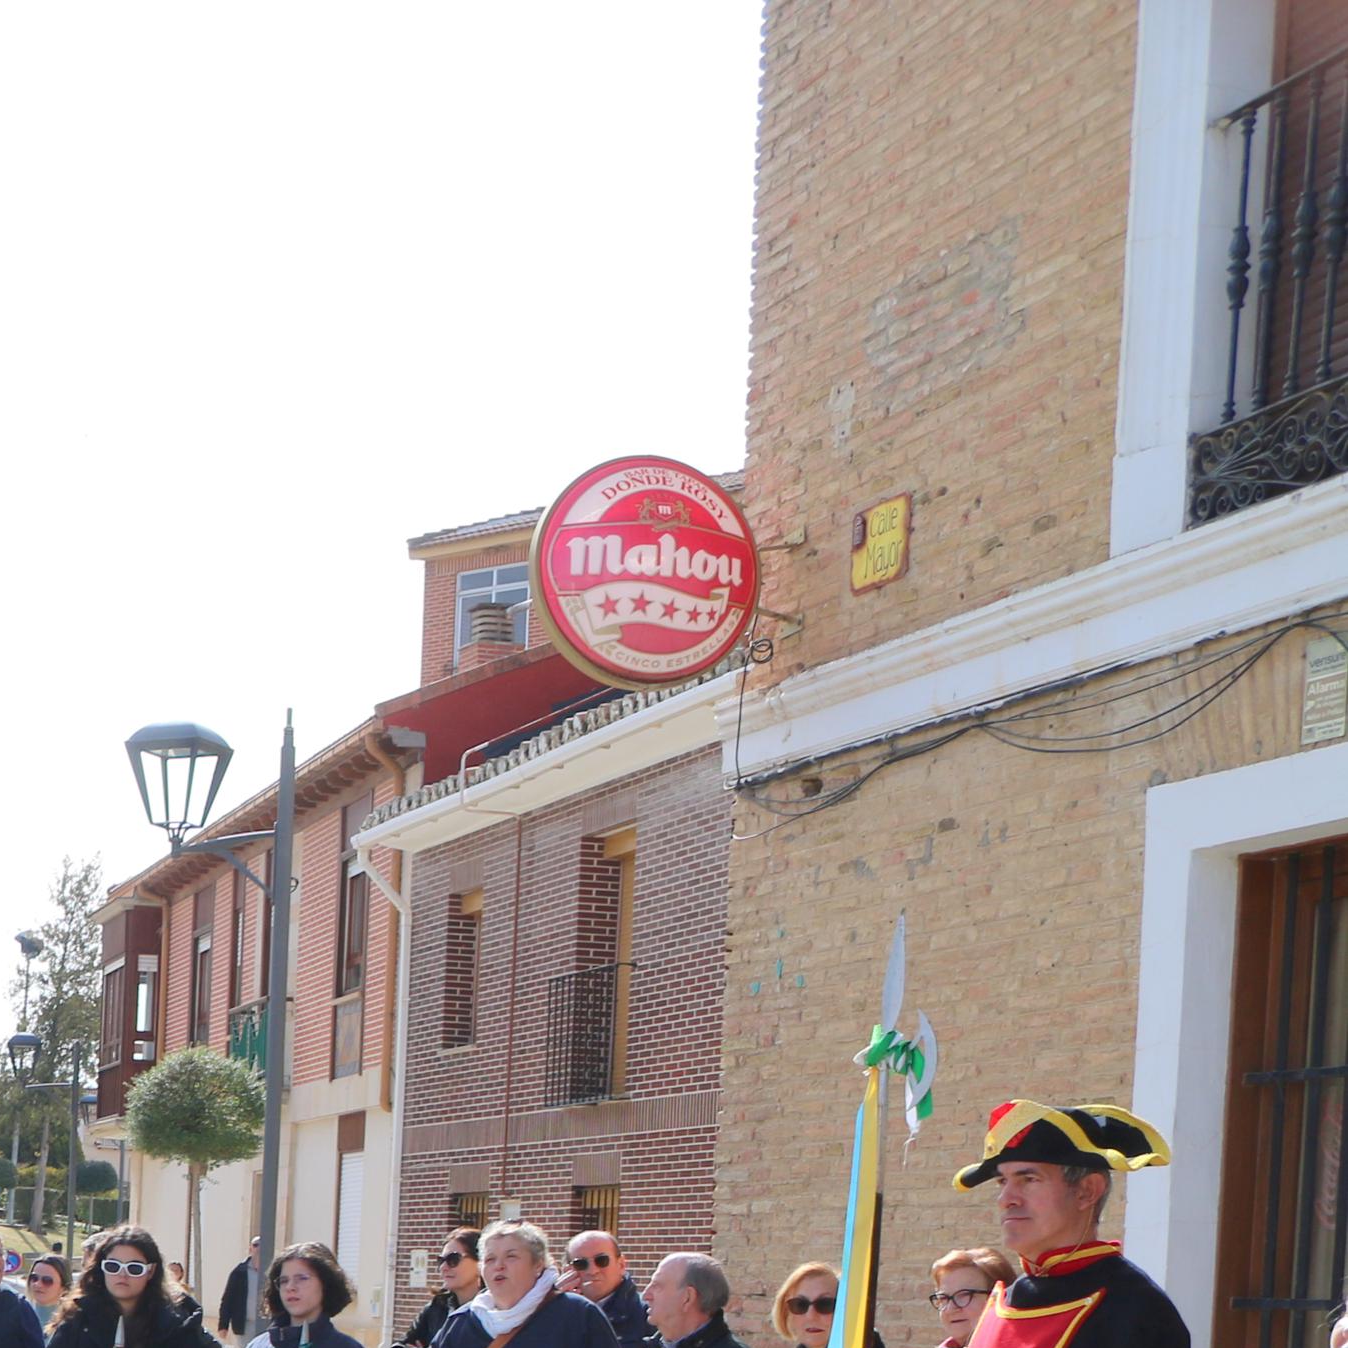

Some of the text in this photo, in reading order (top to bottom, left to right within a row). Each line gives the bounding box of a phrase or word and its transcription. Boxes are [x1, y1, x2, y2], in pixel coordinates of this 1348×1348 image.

[601, 475, 729, 520] DONDE ROSY
[869, 507, 898, 538] Calle
[864, 538, 903, 579] Mayor
[615, 618, 736, 669] CINCO ESTRELLAS
